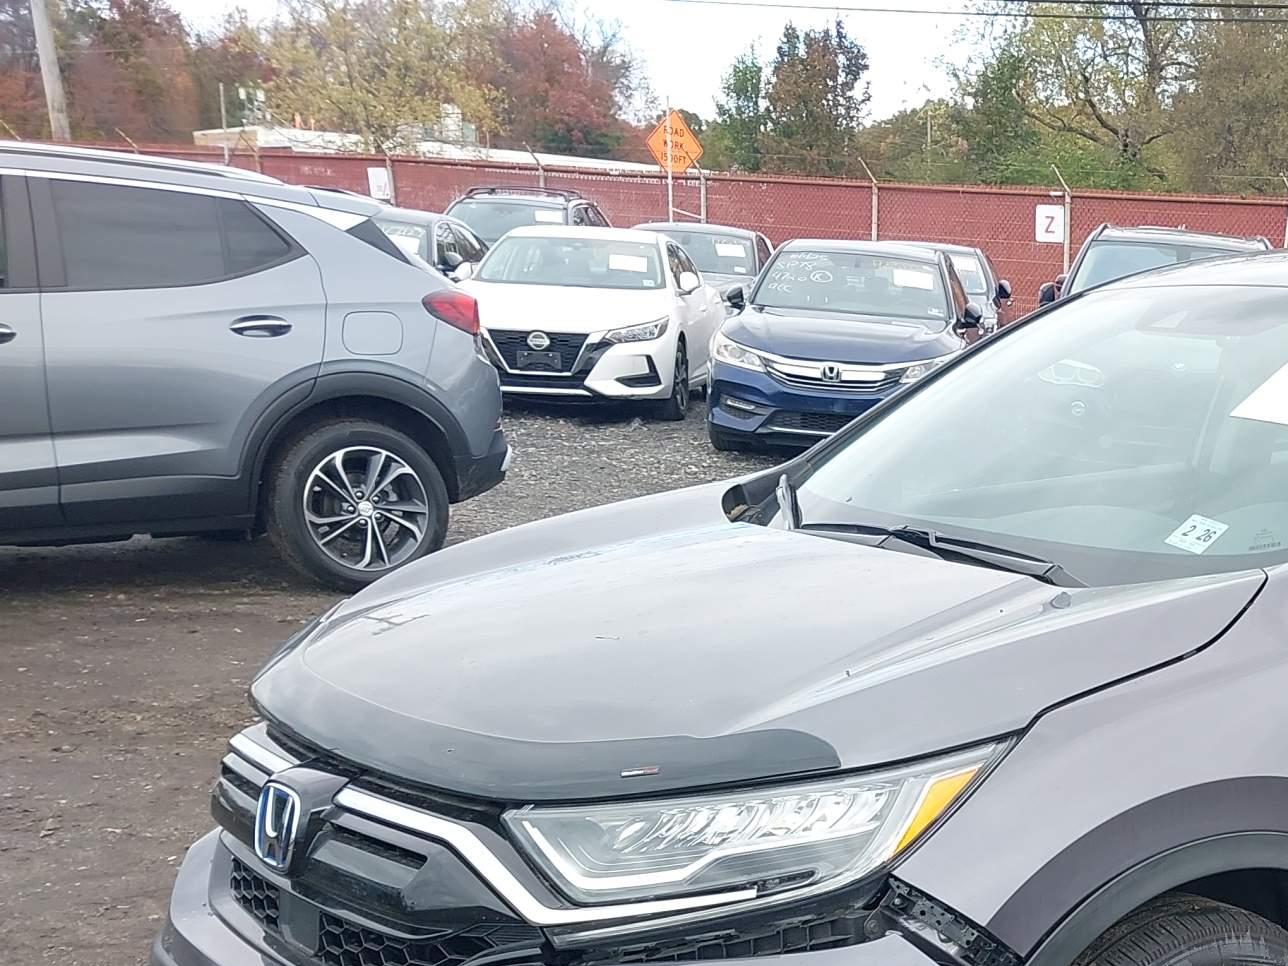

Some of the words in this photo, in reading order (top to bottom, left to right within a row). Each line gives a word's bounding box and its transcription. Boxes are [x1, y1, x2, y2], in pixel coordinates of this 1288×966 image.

[1045, 215, 1056, 234] Z
[1181, 525, 1197, 537] 2
[1195, 528, 1217, 543] 26
